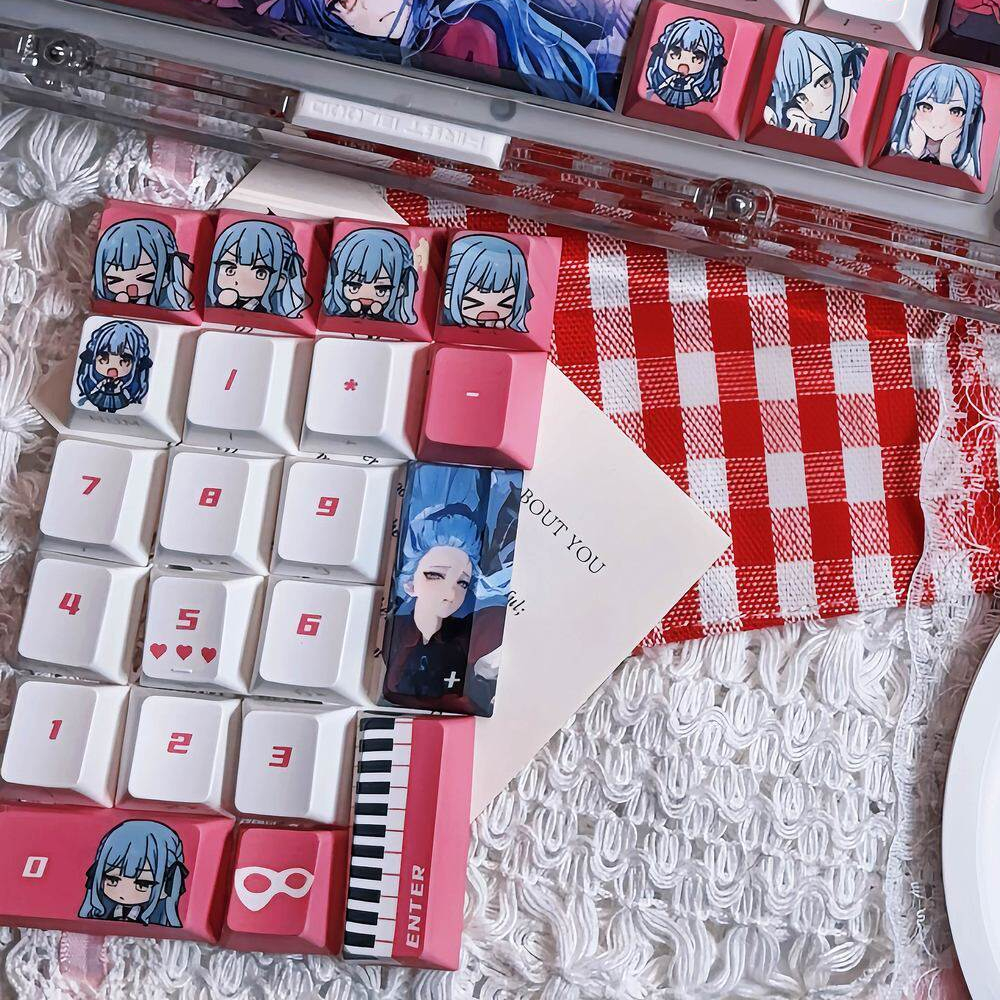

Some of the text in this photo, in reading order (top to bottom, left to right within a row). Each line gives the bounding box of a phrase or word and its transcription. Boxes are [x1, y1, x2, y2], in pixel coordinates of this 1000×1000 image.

[82, 476, 101, 495] 7
[199, 488, 222, 507] 8
[316, 497, 339, 516] 9
[520, 488, 606, 573] BOUT YOU
[59, 593, 81, 615] 4
[176, 609, 200, 630] 5
[297, 614, 322, 636] 6
[443, 671, 461, 688] +
[49, 720, 62, 740] 1
[167, 733, 192, 754] 2
[269, 746, 292, 767] 3
[23, 857, 48, 877] 0
[406, 864, 425, 949] ENTER
